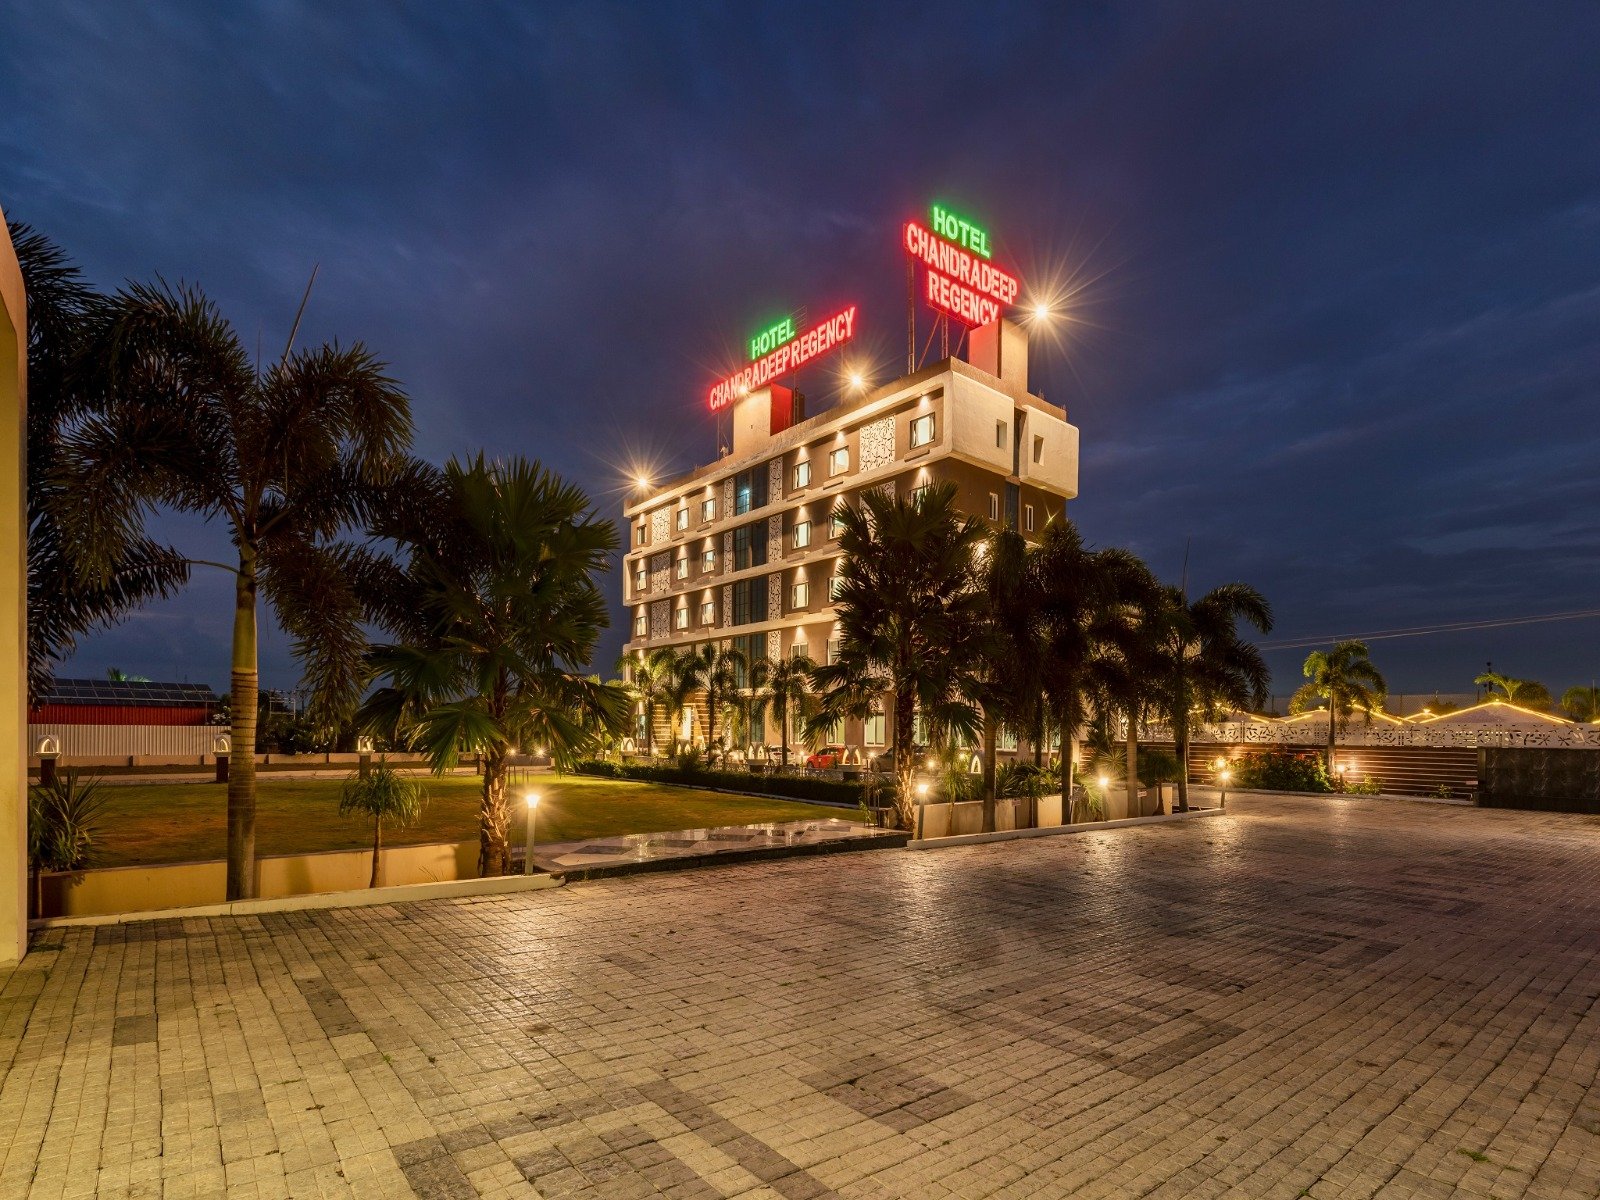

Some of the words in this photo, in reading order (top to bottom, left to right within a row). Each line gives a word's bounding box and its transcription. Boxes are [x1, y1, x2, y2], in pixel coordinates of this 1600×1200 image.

[933, 206, 991, 259] HOTEL
[906, 223, 1018, 305] CHANDRADEEP
[928, 270, 999, 326] REGENCY
[751, 318, 796, 360] HOTEL
